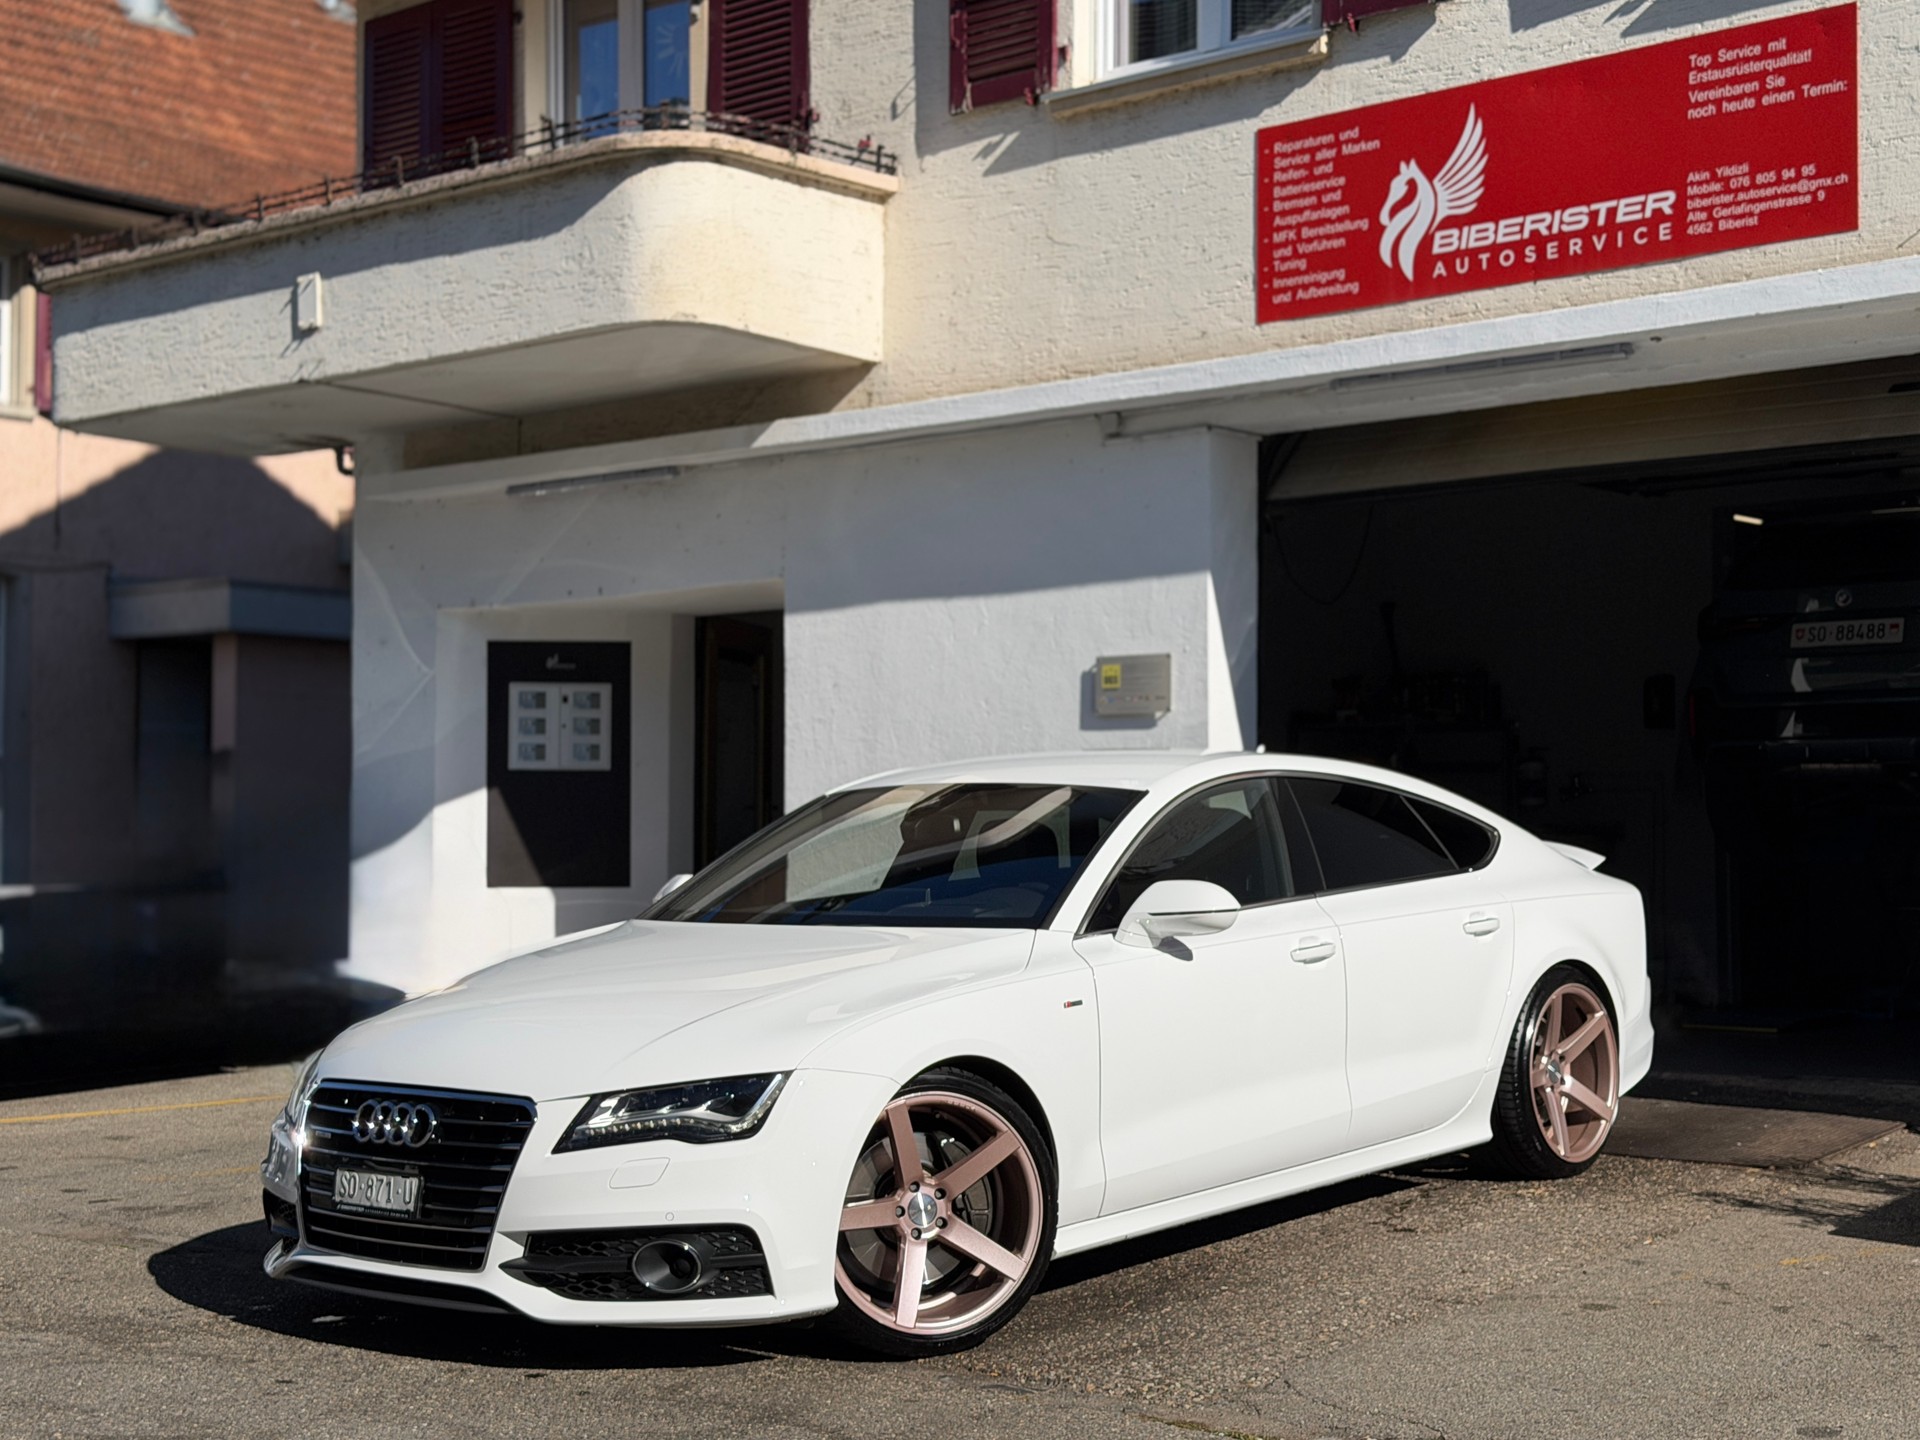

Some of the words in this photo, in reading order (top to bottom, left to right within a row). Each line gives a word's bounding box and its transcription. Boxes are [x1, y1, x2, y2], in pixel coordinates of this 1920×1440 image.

[1688, 54, 1712, 69] Top
[1718, 44, 1762, 63] Service
[1768, 37, 1787, 52] mit
[1687, 105, 1716, 120] noch
[1722, 97, 1756, 114] heute
[1761, 89, 1795, 106] einen
[1801, 79, 1848, 98] Termin:
[1688, 80, 1759, 103] Vereinbaren
[1765, 74, 1786, 89] Sie
[1273, 132, 1335, 155] Reparaturen
[1339, 126, 1360, 142] und
[1273, 153, 1311, 170] Service
[1315, 147, 1337, 162] aller
[1342, 139, 1380, 156] Marken
[1313, 162, 1334, 176] und
[1686, 170, 1710, 184] Akin
[1686, 182, 1724, 197] Mobile:
[1729, 177, 1750, 190] 076
[1755, 171, 1777, 185] 805
[1781, 167, 1796, 181] 94
[1801, 163, 1816, 177] 95
[1273, 175, 1346, 199] Batterieservice
[1273, 196, 1317, 213] Bremsen
[1321, 189, 1342, 204] und
[1686, 210, 1707, 223] Alte
[1817, 190, 1826, 202] 9
[1273, 204, 1350, 228] Auspuffanlagen
[1431, 189, 1677, 255] BIBERISTER
[1686, 222, 1713, 236] 4562
[1718, 215, 1759, 232] Biberist
[1272, 229, 1297, 244] MFK
[1301, 217, 1369, 239] Bereitstellung
[1273, 245, 1293, 259] und
[1432, 222, 1673, 279] AUTOSERVICE
[1273, 257, 1307, 273] Tuning
[1272, 267, 1346, 289] Innenreinigung
[1272, 289, 1292, 304] und
[1296, 282, 1360, 301] Aufbereitung
